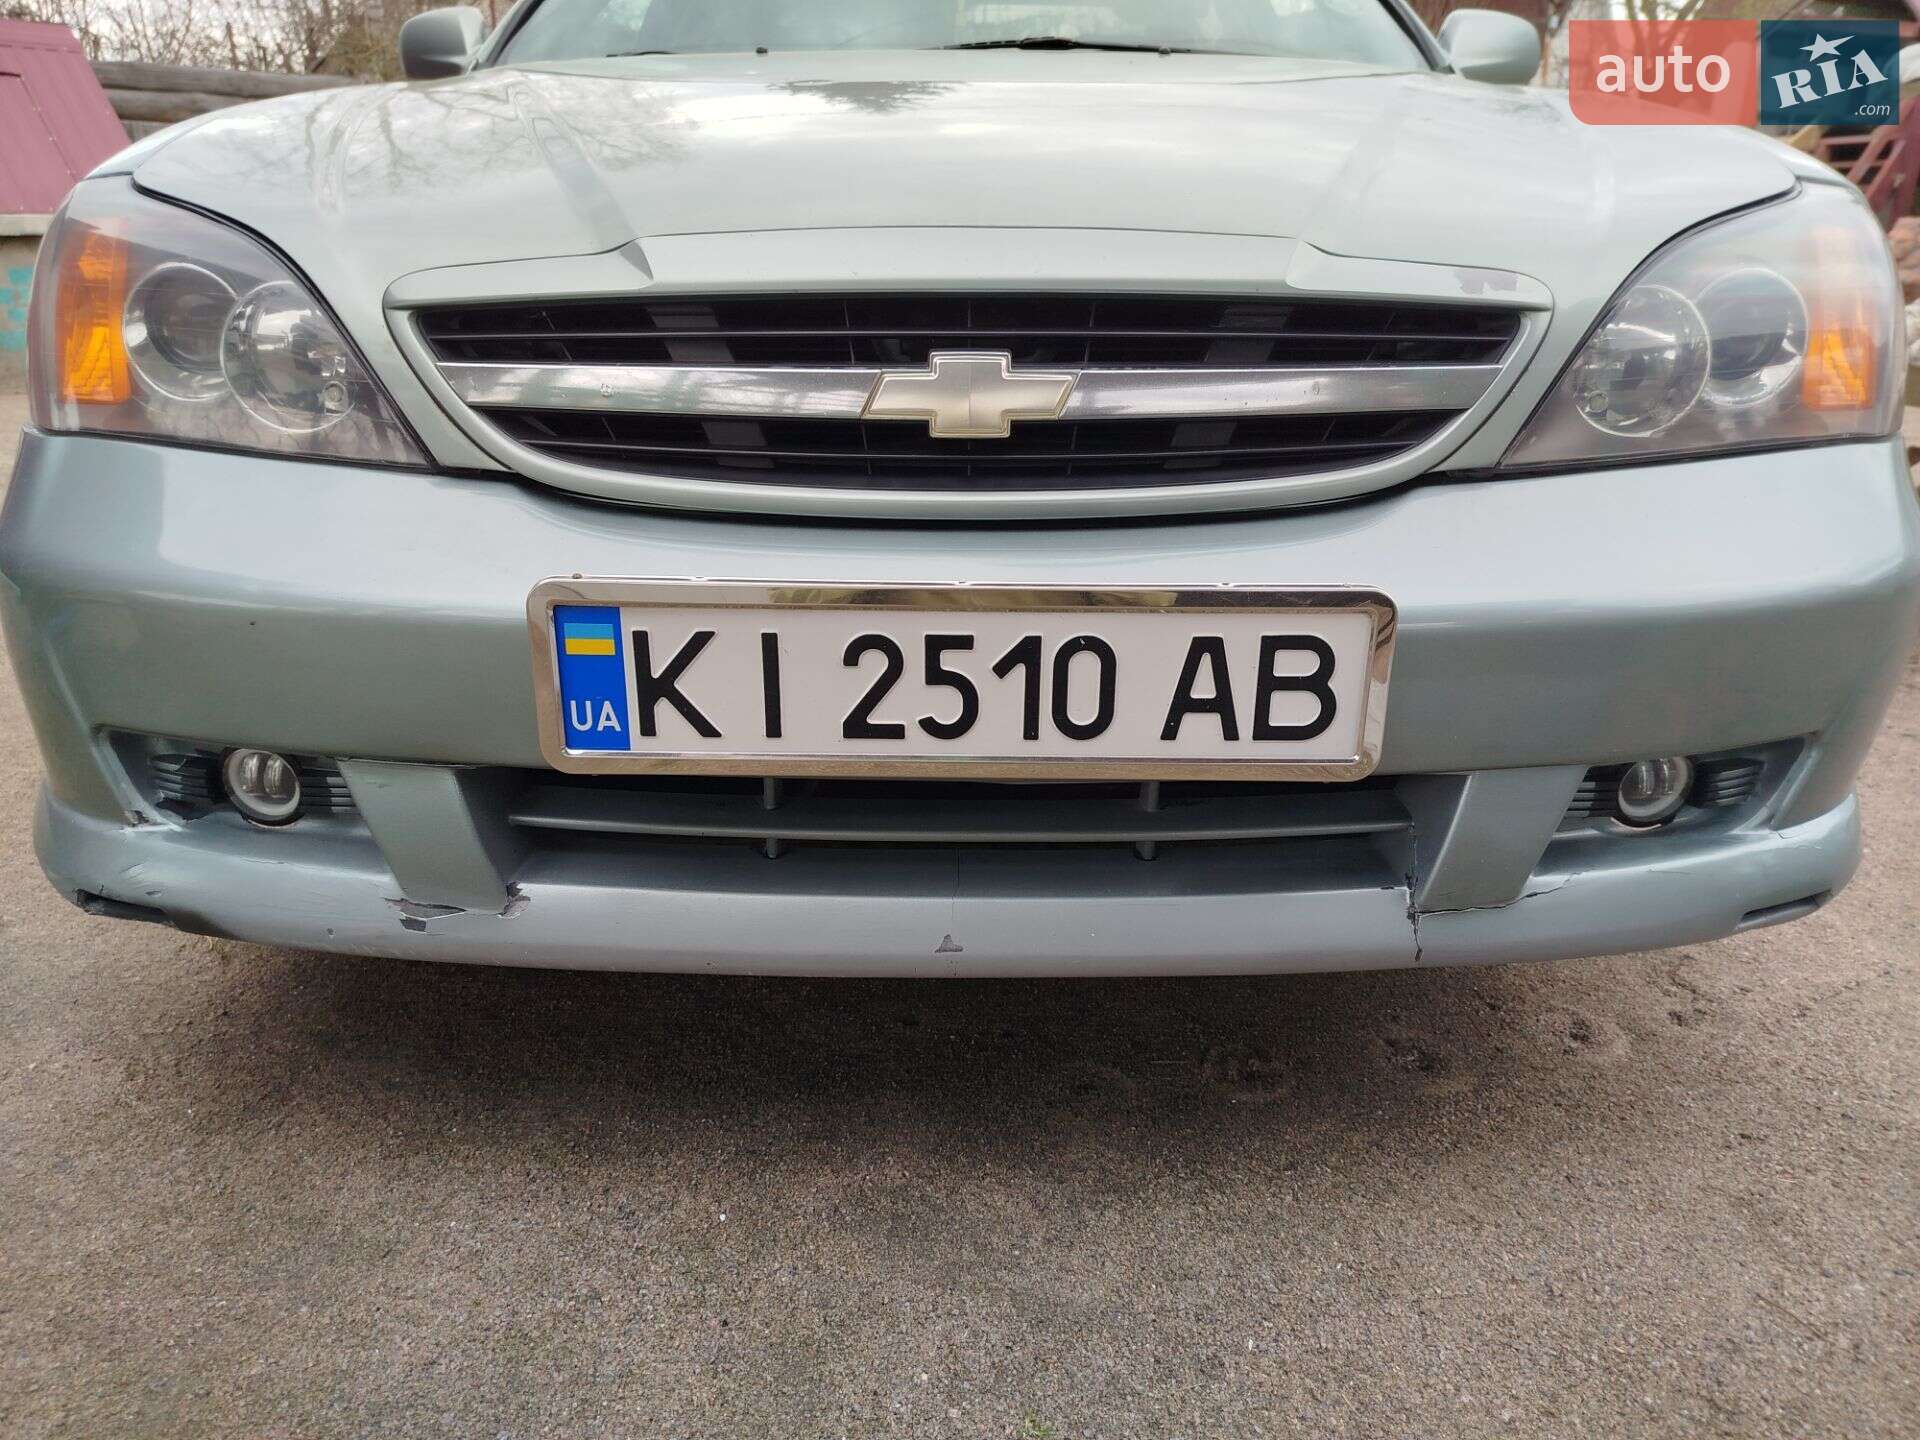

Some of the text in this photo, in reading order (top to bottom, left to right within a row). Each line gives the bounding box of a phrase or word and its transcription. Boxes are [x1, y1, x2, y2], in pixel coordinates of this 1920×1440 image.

[570, 699, 623, 732] UA
[631, 630, 1337, 742] KI 2510 AB
